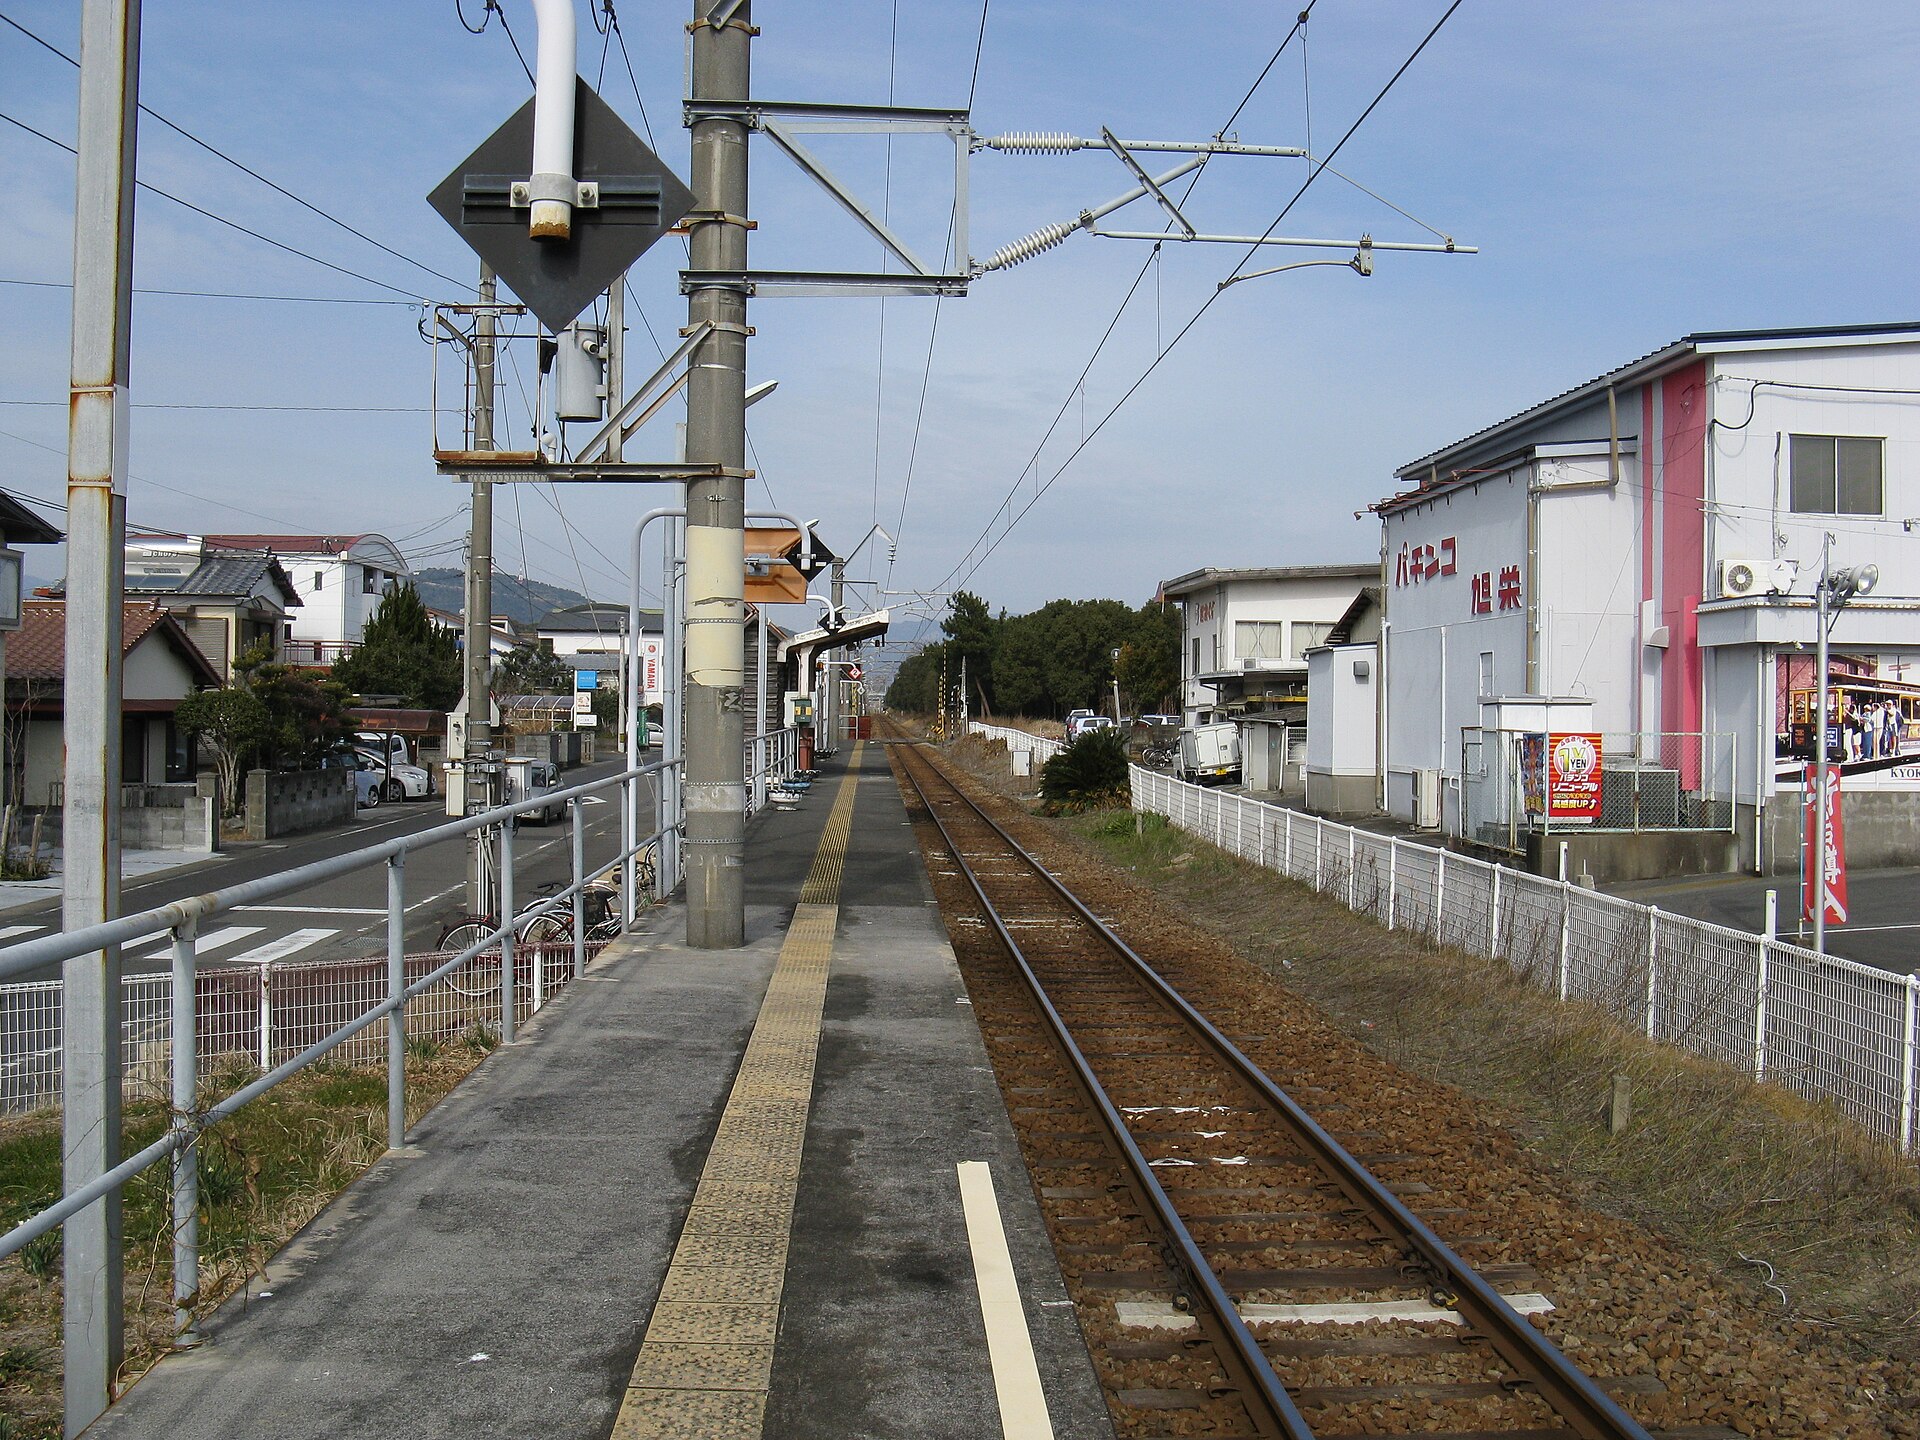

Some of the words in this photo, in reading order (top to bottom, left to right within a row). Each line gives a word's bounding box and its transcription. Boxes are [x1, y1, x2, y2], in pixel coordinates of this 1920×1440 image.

[1395, 535, 1459, 588] パチンコ
[1471, 564, 1523, 616] 旭栄
[647, 658, 656, 689] YAMAHA
[1570, 759, 1587, 769] YEN
[1552, 782, 1599, 792] リニューアル
[1559, 774, 1589, 782] パチンコ
